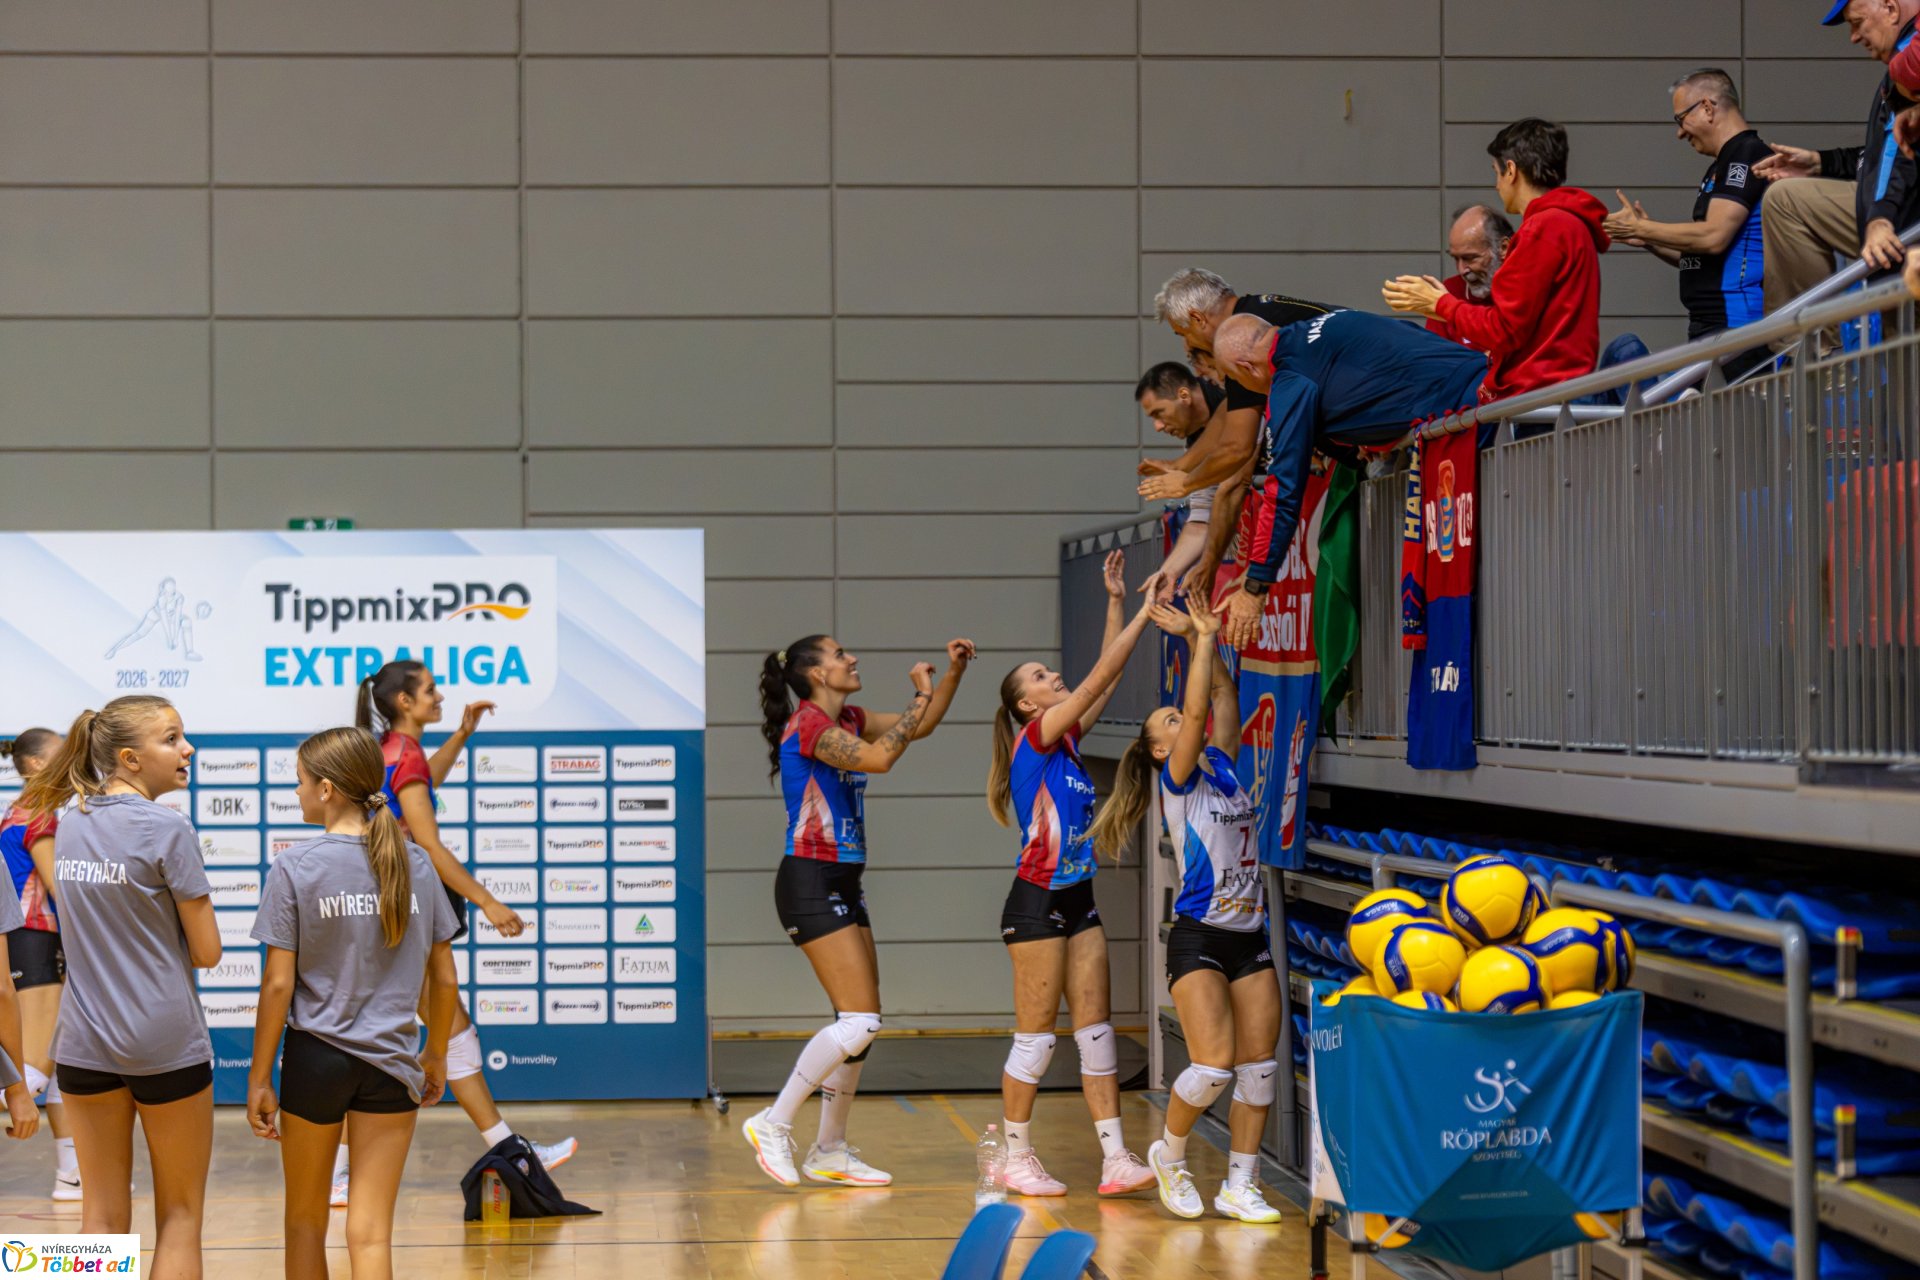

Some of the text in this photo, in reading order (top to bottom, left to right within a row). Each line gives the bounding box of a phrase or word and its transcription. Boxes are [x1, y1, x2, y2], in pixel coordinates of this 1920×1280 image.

[265, 583, 531, 632] TippmixPRO
[116, 669, 148, 688] 2026
[158, 669, 190, 688] 2027
[550, 760, 601, 770] STRABAG
[616, 759, 672, 770] TippmixPRO
[478, 800, 535, 811] TippmixPRO
[547, 840, 604, 851] TippmixPRO
[617, 880, 673, 890] TippmixPRO
[319, 891, 420, 919] NYÍREGYA
[548, 961, 604, 973] TippmixPRO
[620, 956, 670, 974] FATUM
[617, 1001, 674, 1012] TippmixPRO
[512, 1054, 558, 1066] hunvolley
[1440, 1126, 1553, 1150] RÖPLABDA
